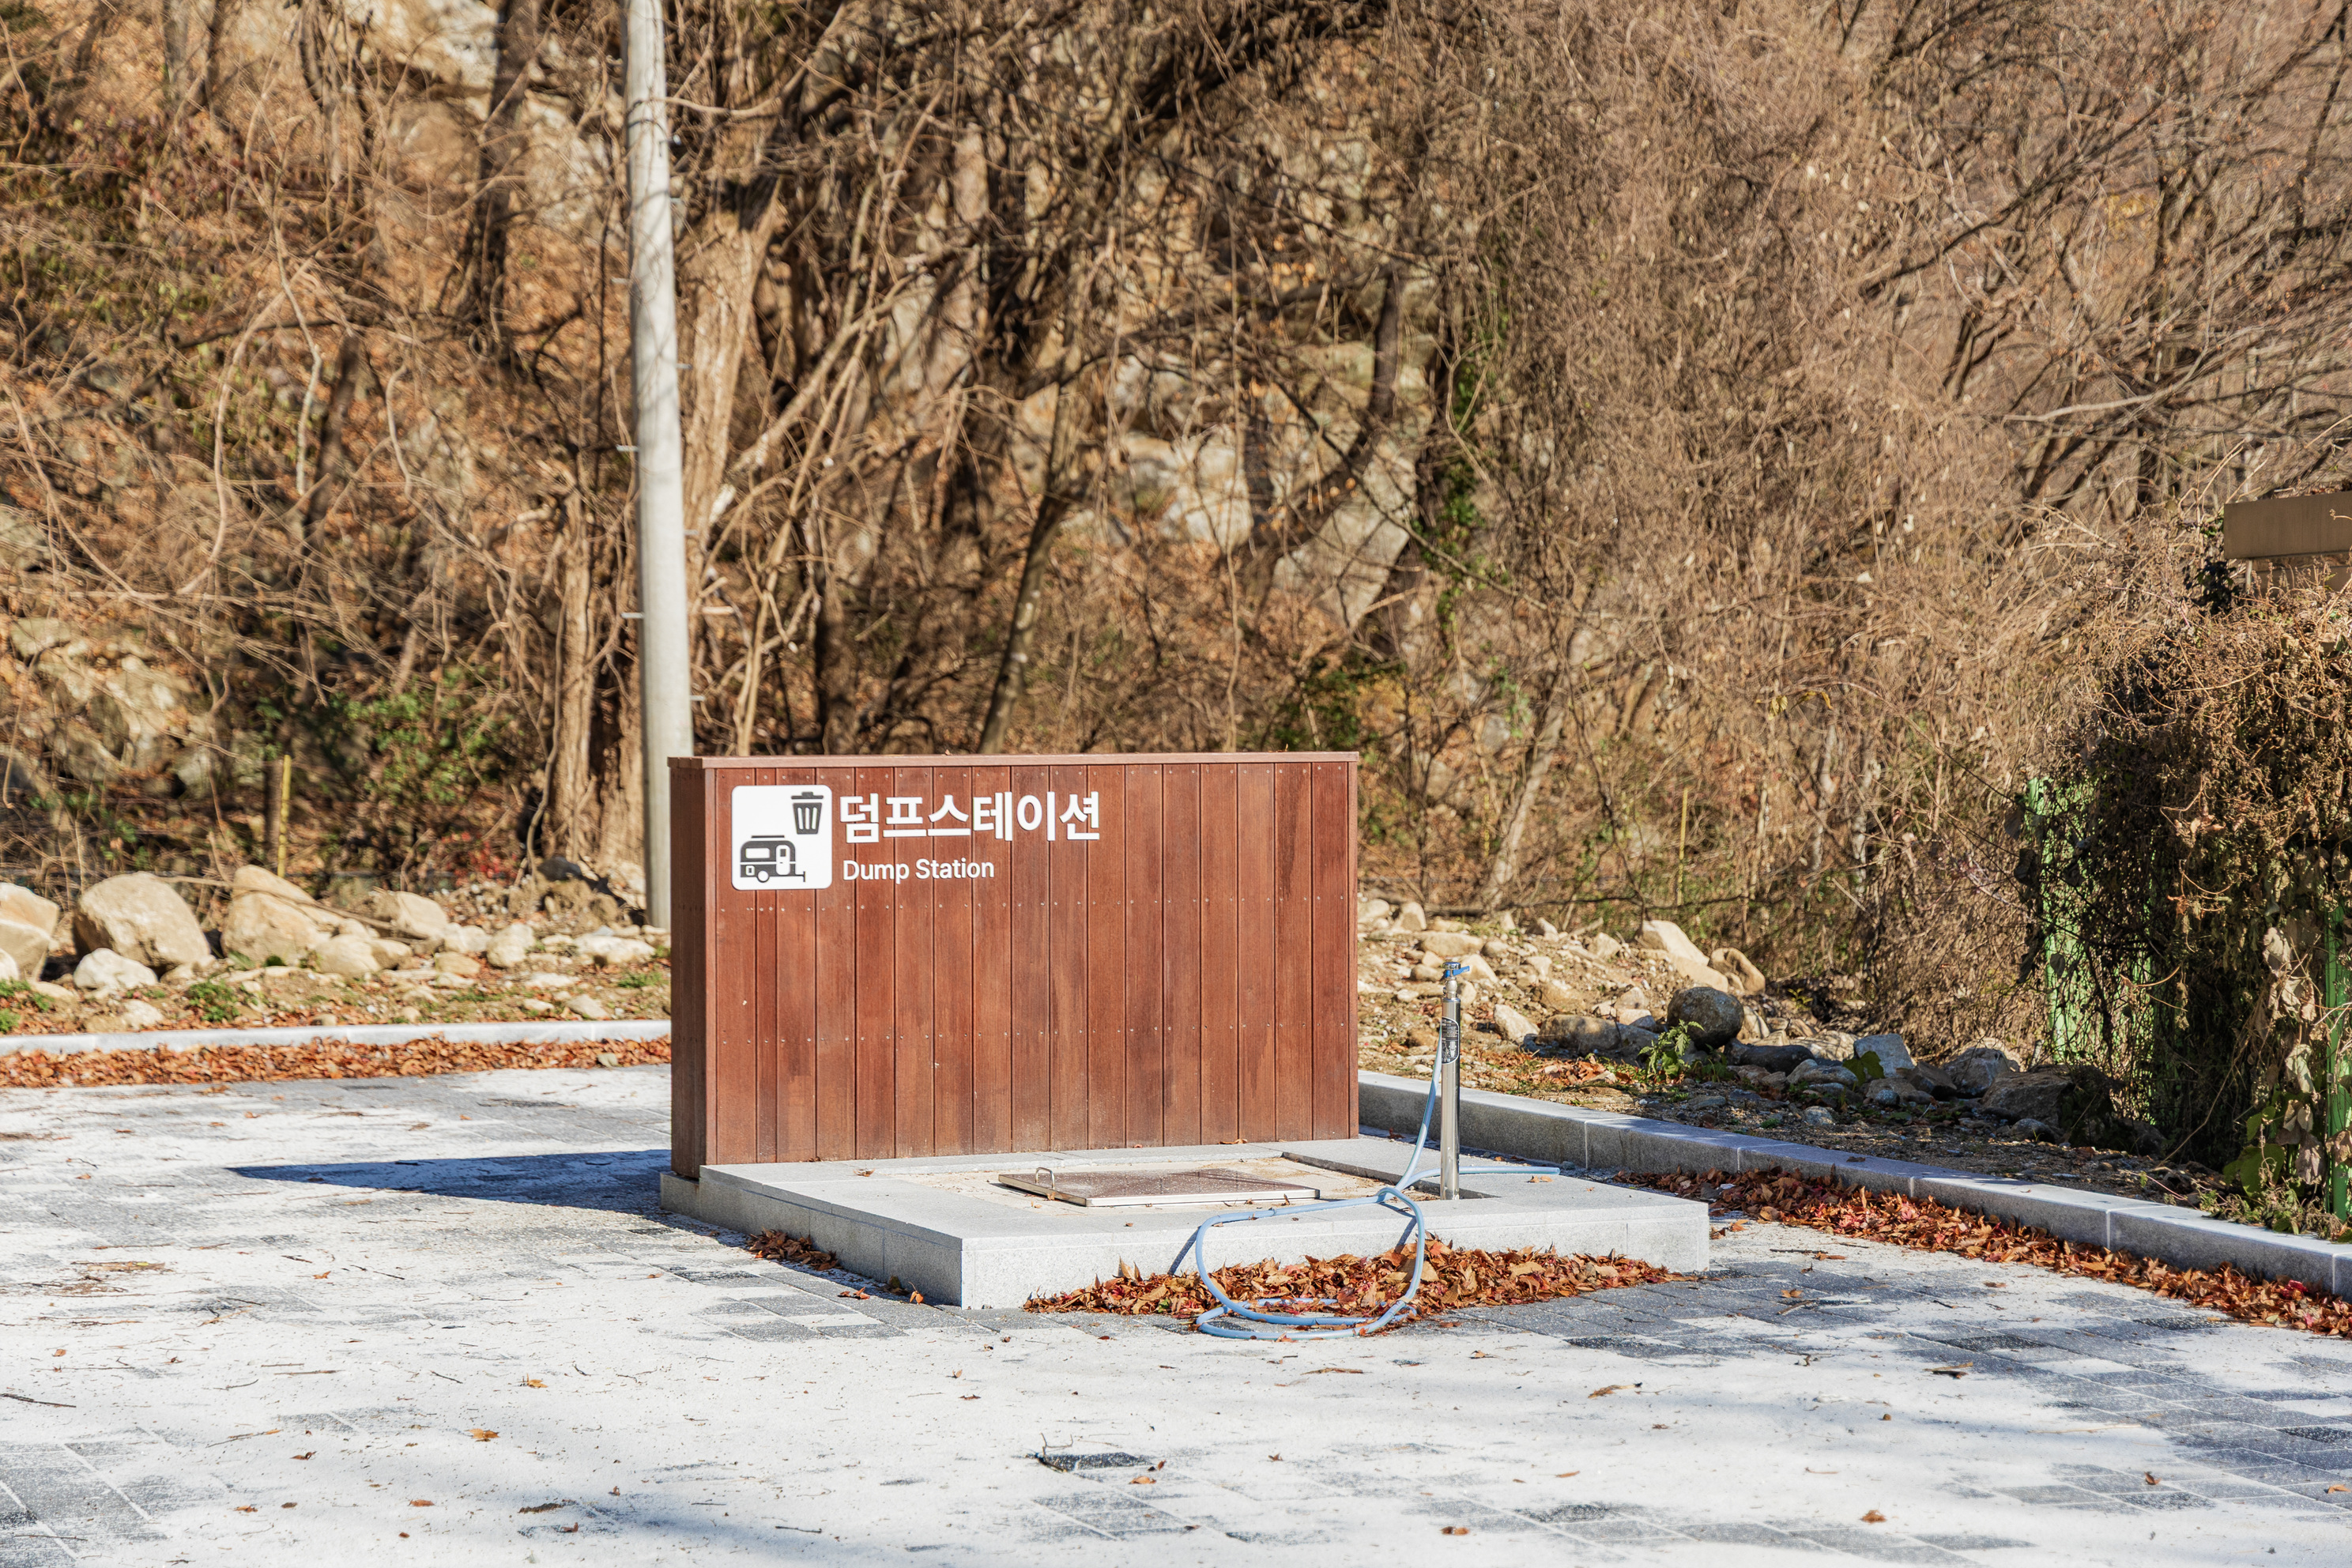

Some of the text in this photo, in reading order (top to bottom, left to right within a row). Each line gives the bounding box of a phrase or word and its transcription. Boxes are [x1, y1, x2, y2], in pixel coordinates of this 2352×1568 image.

[839, 790, 1100, 843] 덤프스테이션
[843, 858, 995, 885] Dump Station
